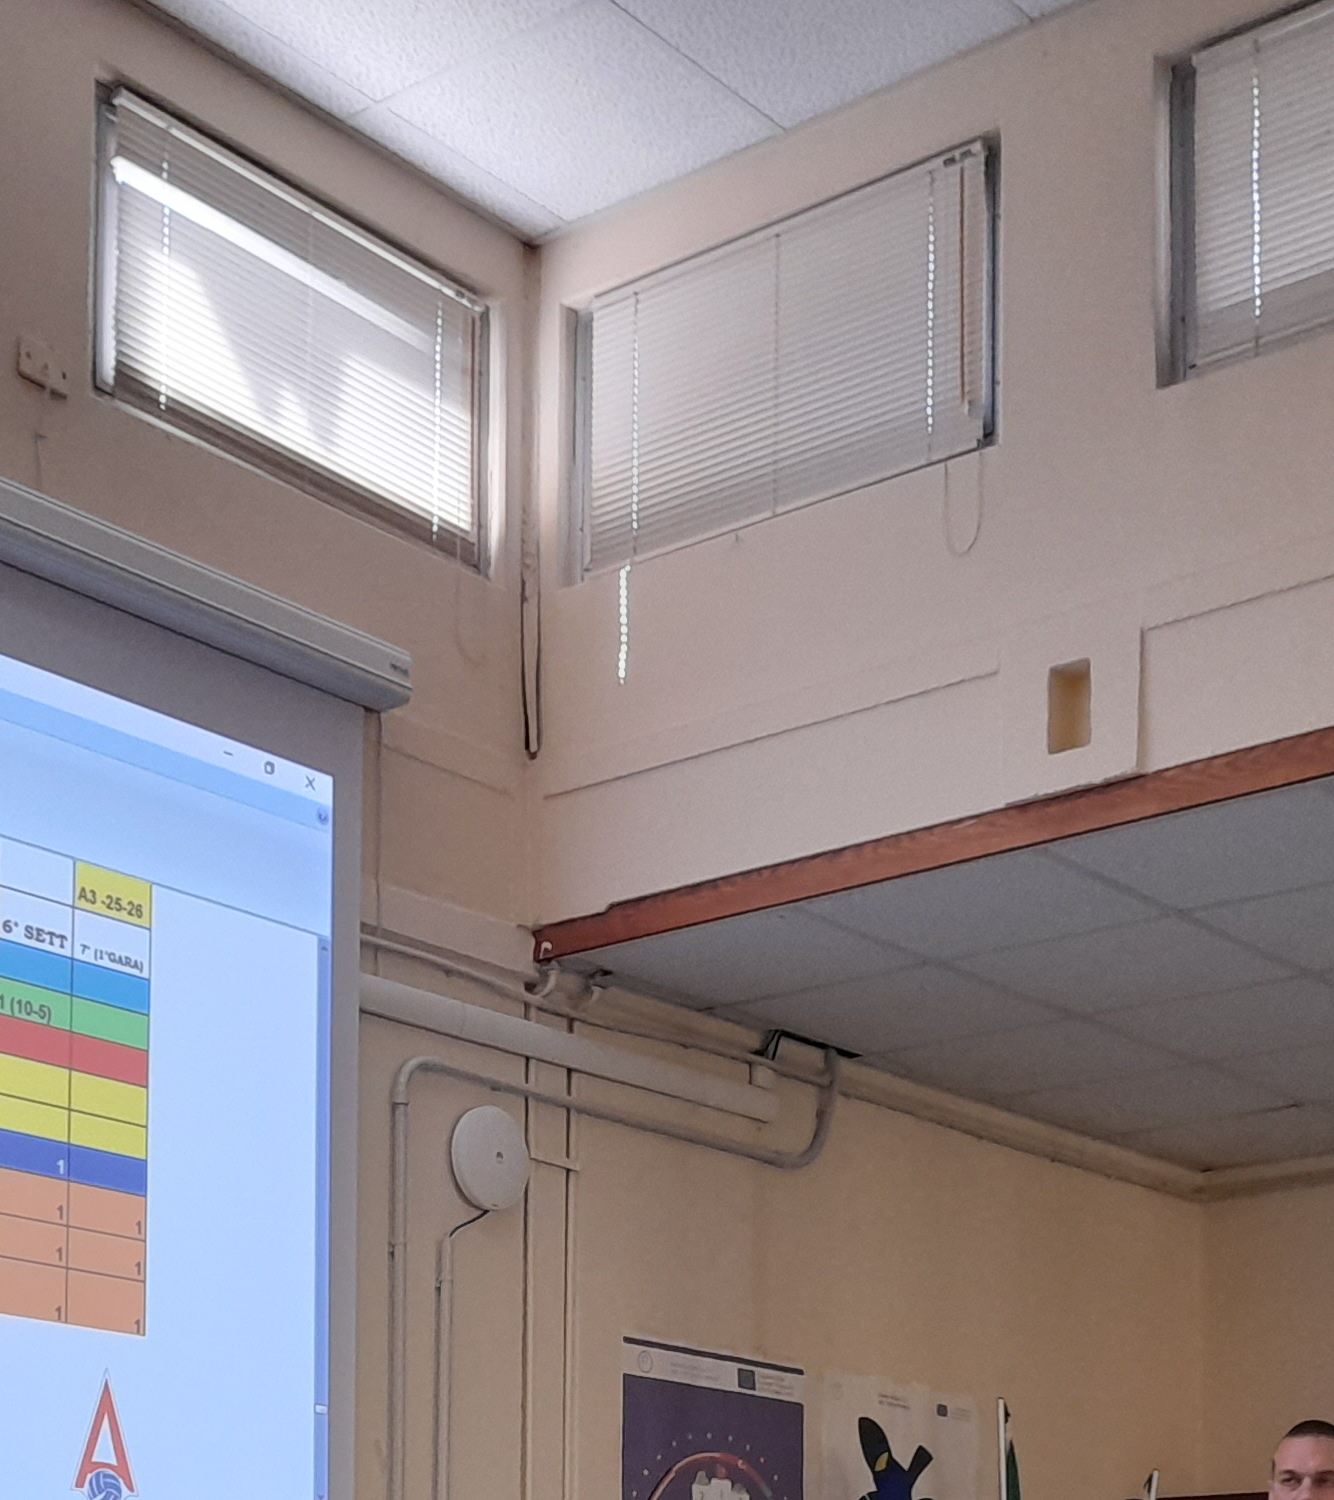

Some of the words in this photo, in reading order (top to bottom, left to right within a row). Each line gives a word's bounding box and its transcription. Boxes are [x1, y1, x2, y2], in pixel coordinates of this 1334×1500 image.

[77, 886, 98, 905] A3
[24, 925, 67, 950] SETT
[10, 998, 52, 1025] (10-5)
[56, 1159, 64, 1175] 1
[56, 1205, 64, 1220] 1
[135, 1220, 143, 1235] 1
